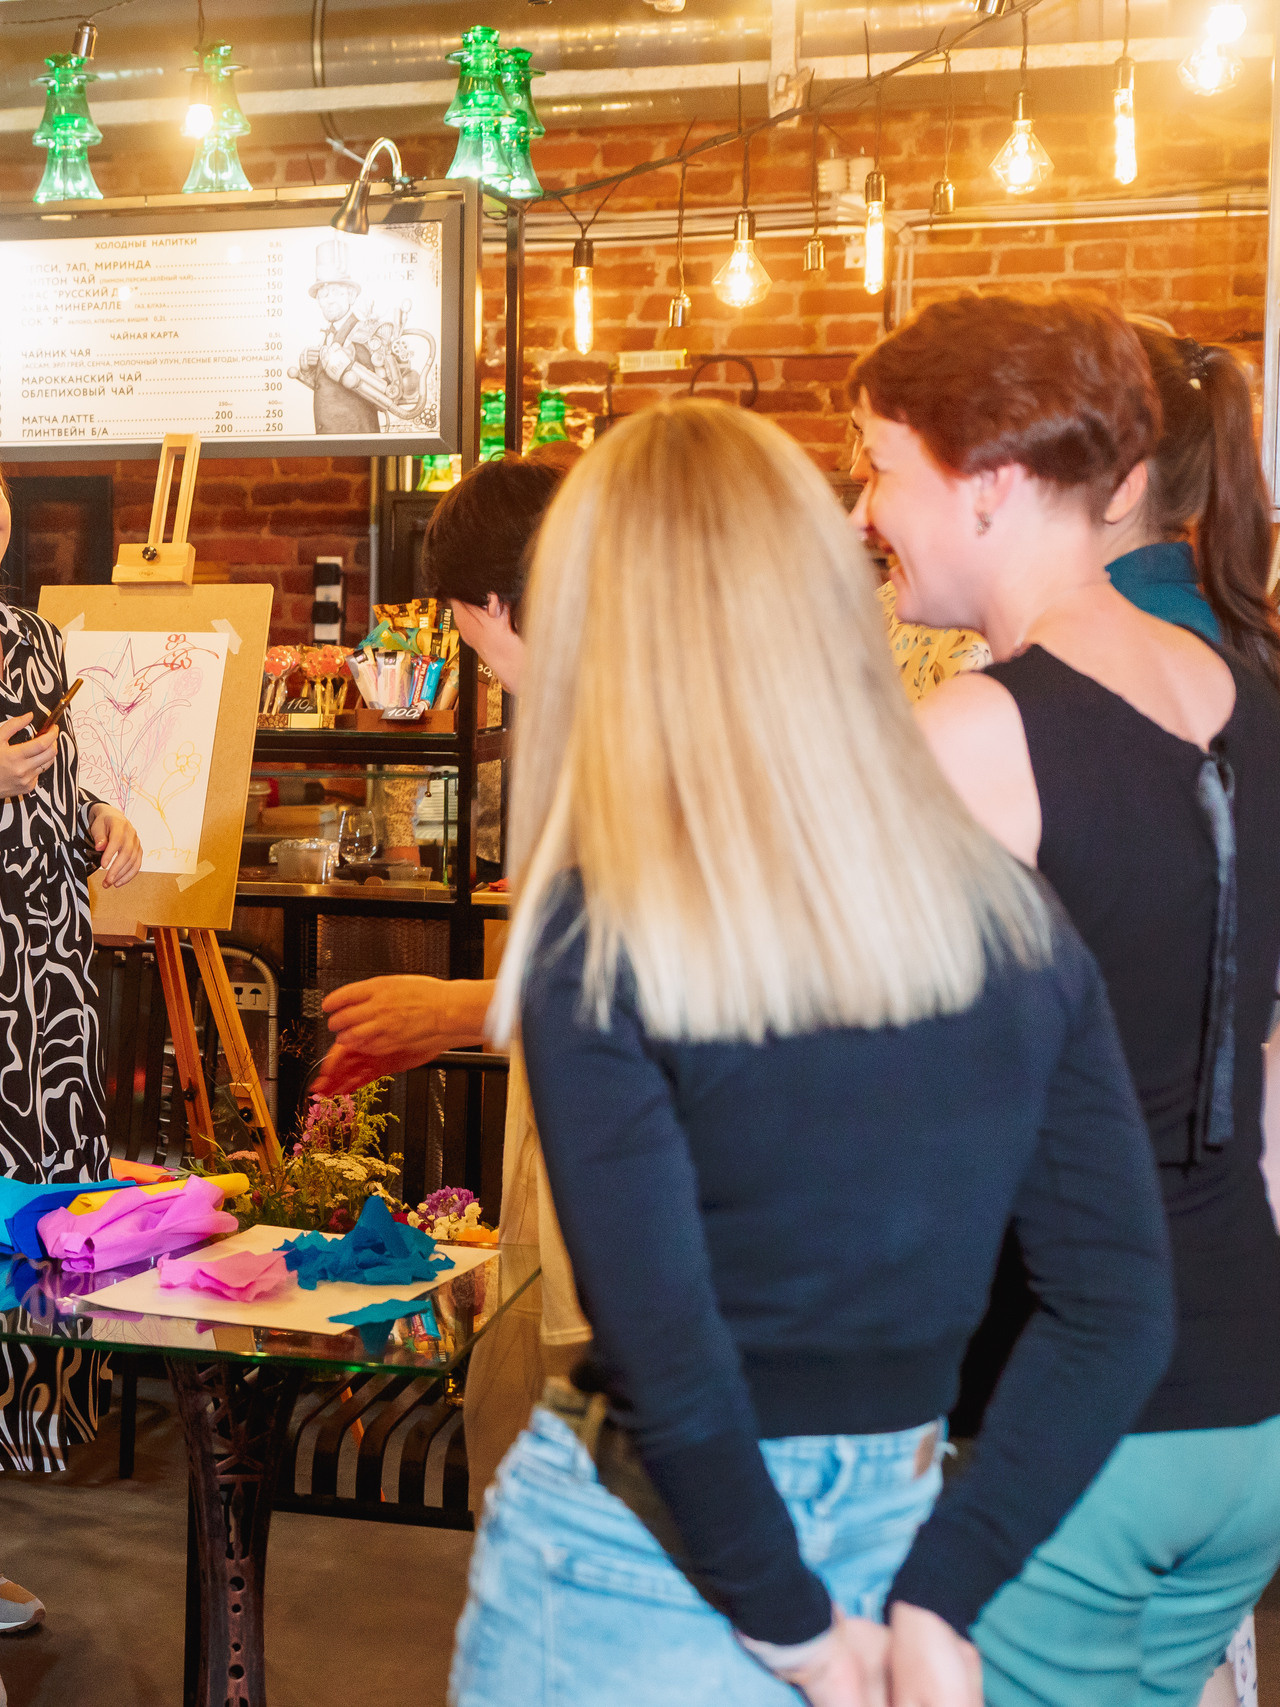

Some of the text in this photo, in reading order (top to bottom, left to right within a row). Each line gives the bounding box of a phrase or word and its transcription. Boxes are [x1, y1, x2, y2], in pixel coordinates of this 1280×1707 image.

[95, 240, 147, 250] ХОЛОДНЫЕ
[152, 238, 197, 247] НАПИТКИ
[28, 254, 283, 274] ЕПСИ, 7АП, МИРИНДА 150
[73, 274, 96, 285] ЧАЙ
[267, 268, 283, 277] 150
[53, 287, 108, 298] "РУССКИЙ
[267, 282, 283, 290] 150
[55, 301, 122, 312] МИНЕРАЛЛЕ
[267, 295, 283, 304] 120
[266, 308, 283, 317] 120
[110, 332, 147, 340] ЧАЙНАЯ
[150, 331, 179, 340] КАРТА
[21, 342, 282, 359] ЧАЙНИК ЧАЯ 300
[114, 357, 157, 366] МОЛОЧНЫЙ
[22, 369, 282, 385] МАРОККАНСКИЙ ЧАЙ 300
[21, 382, 282, 398] ОБЛЕПИХОВЫЙ ЧАЙ 300
[22, 409, 283, 425] МАТЧА ЛАТТЕ 200 250
[22, 423, 283, 438] ГЛИНТВЕЙН Б/А 200 250
[413, 675, 424, 703] COCONUT
